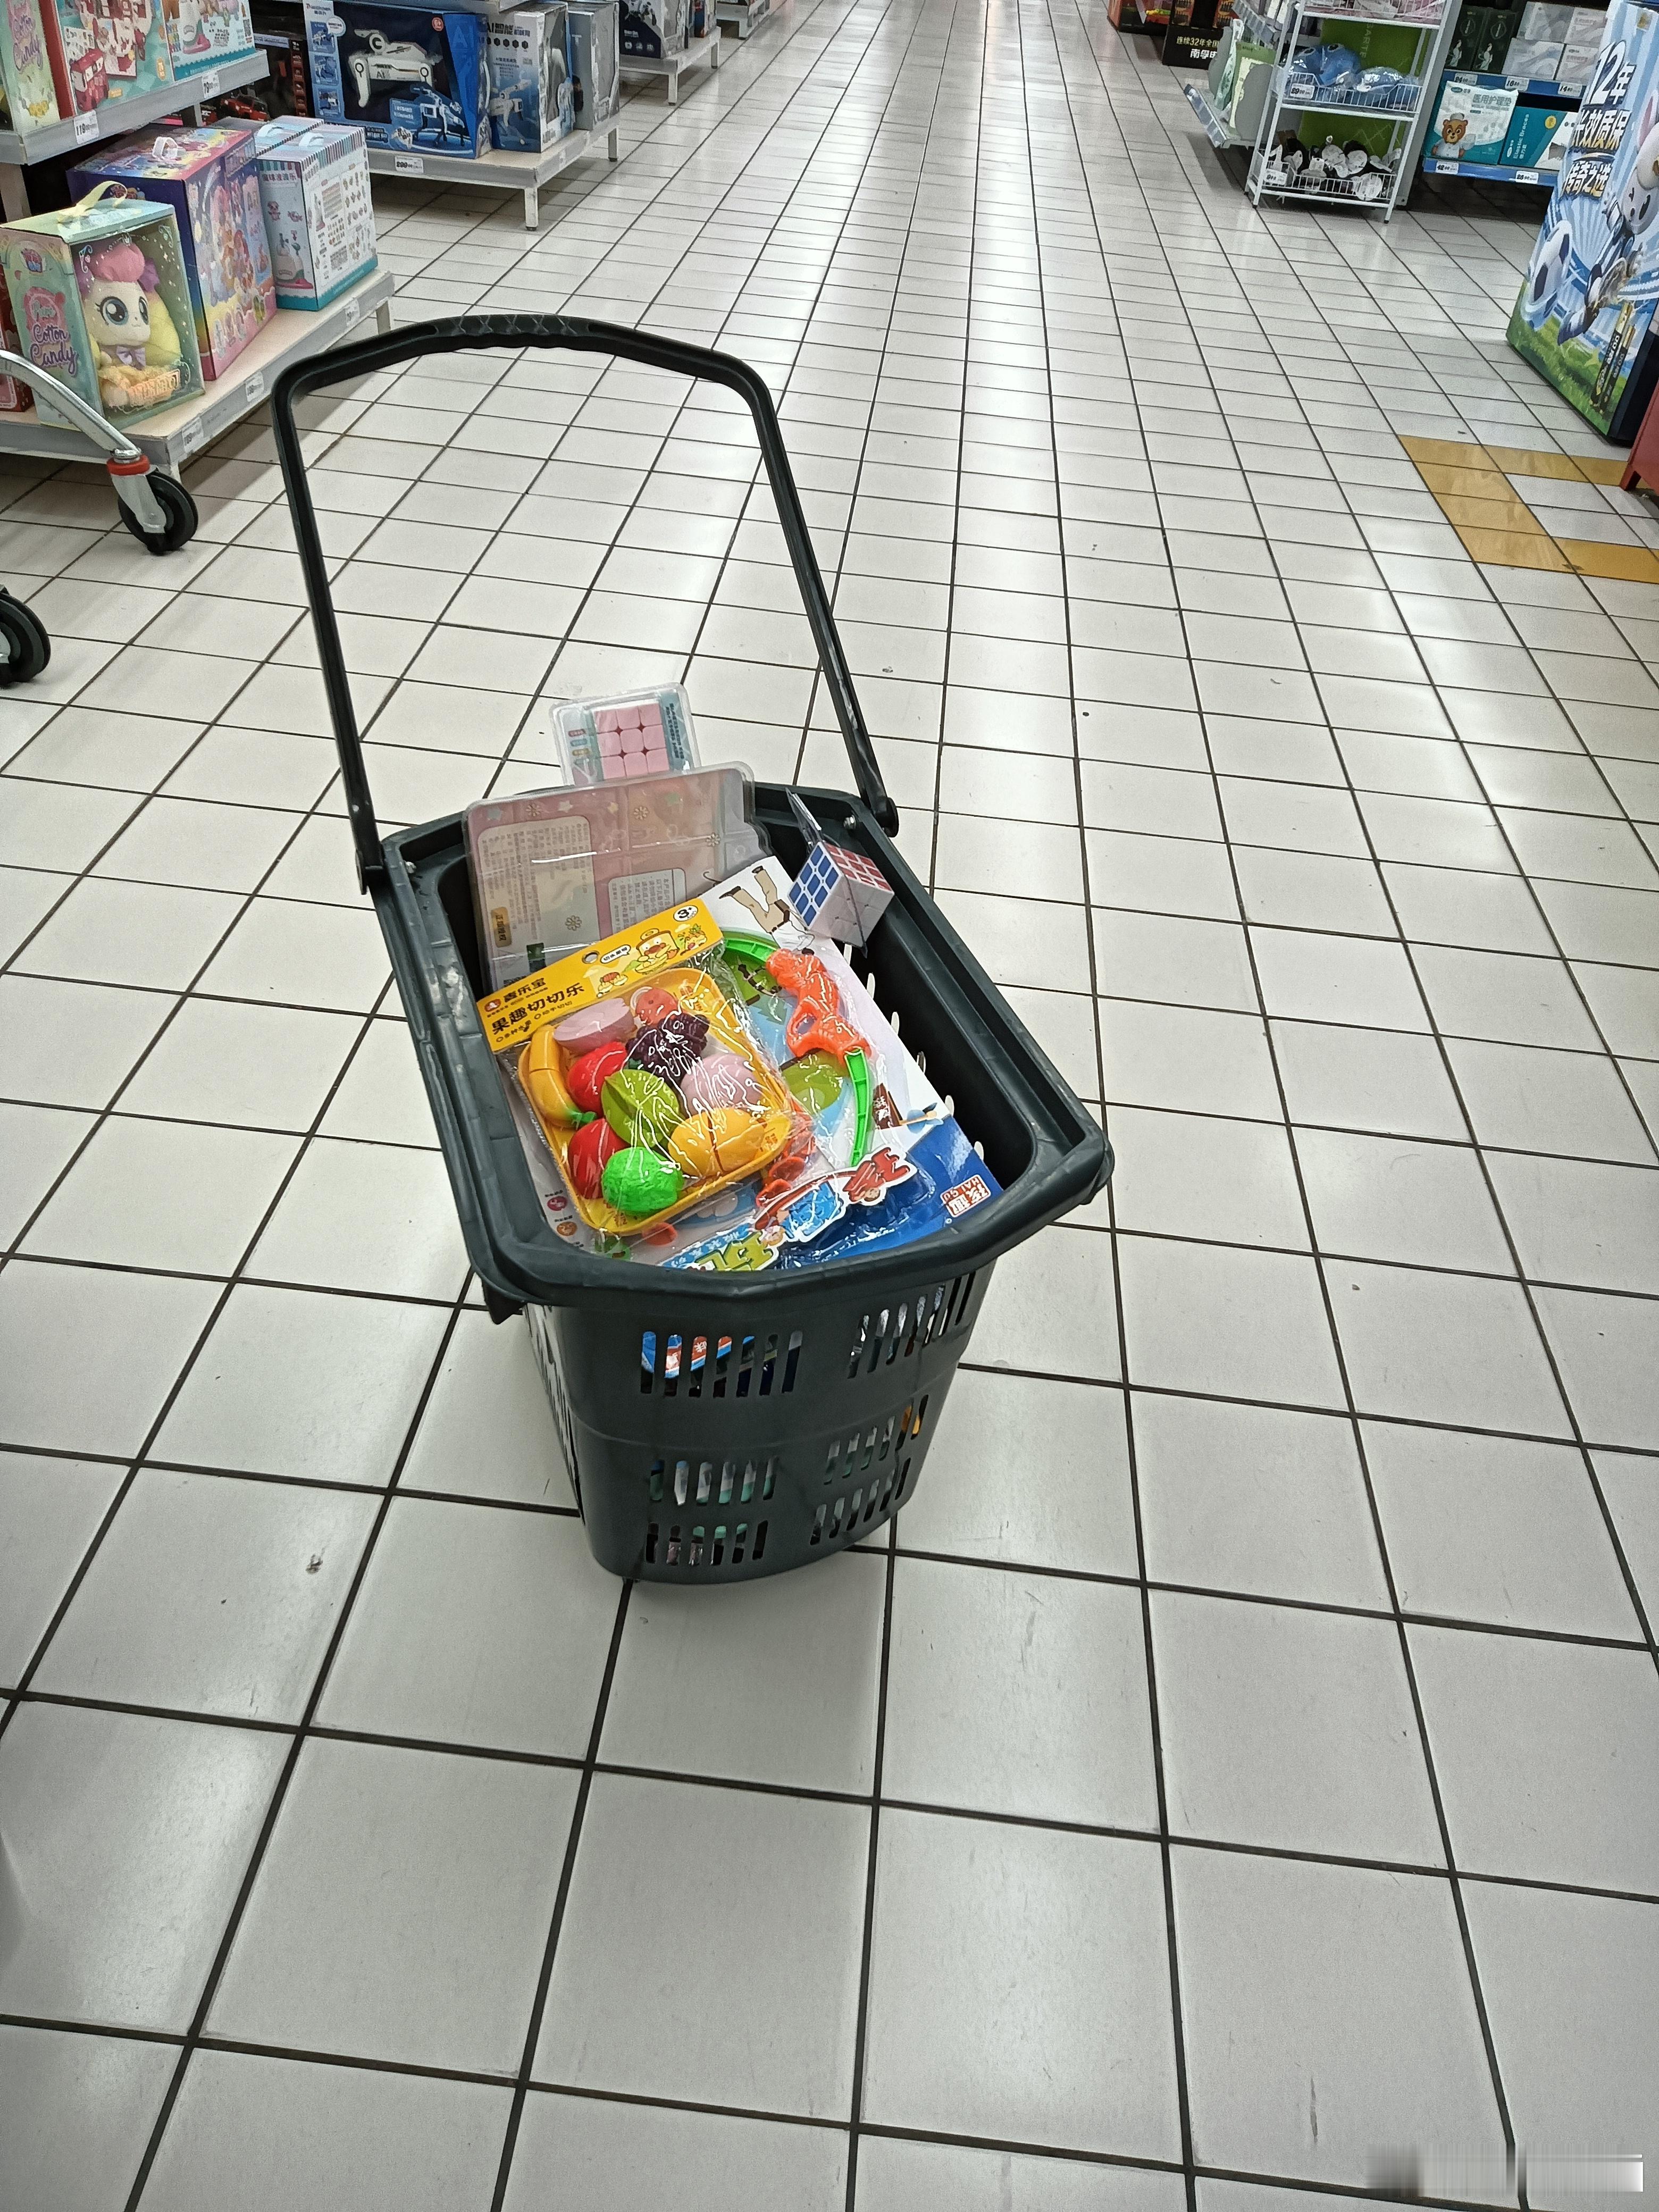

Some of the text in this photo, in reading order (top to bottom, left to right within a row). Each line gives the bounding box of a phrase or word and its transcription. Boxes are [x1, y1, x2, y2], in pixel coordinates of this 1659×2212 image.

[33, 323, 70, 343] Cotton
[30, 339, 79, 374] Candy
[492, 982, 585, 1035] 果趣切切乐
[960, 1177, 980, 1192] HAI
